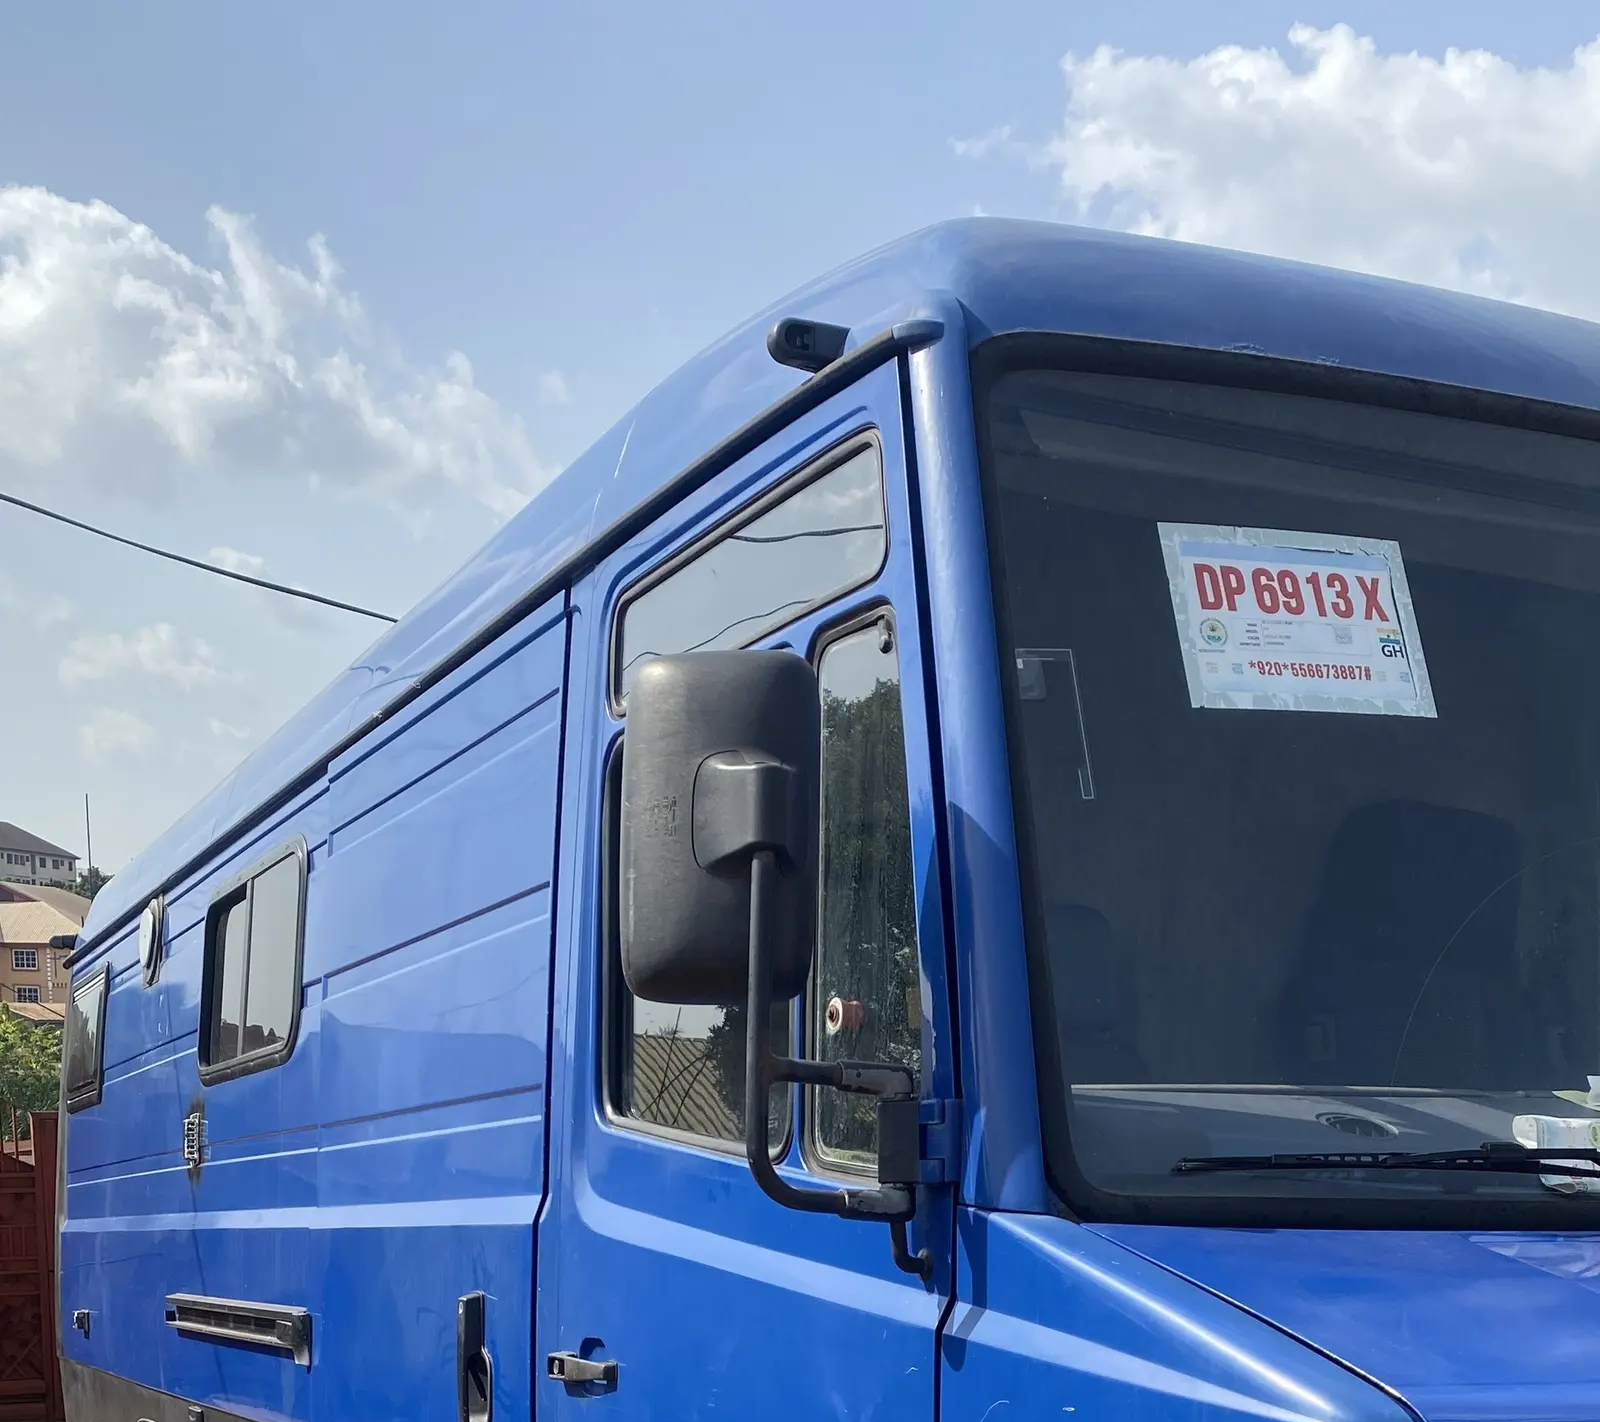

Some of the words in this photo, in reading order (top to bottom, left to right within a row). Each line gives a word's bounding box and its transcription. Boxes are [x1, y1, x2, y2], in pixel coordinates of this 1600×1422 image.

[1193, 562, 1246, 612] DP
[1251, 567, 1354, 618] 6913
[1355, 575, 1389, 622] X
[1381, 644, 1405, 659] GH
